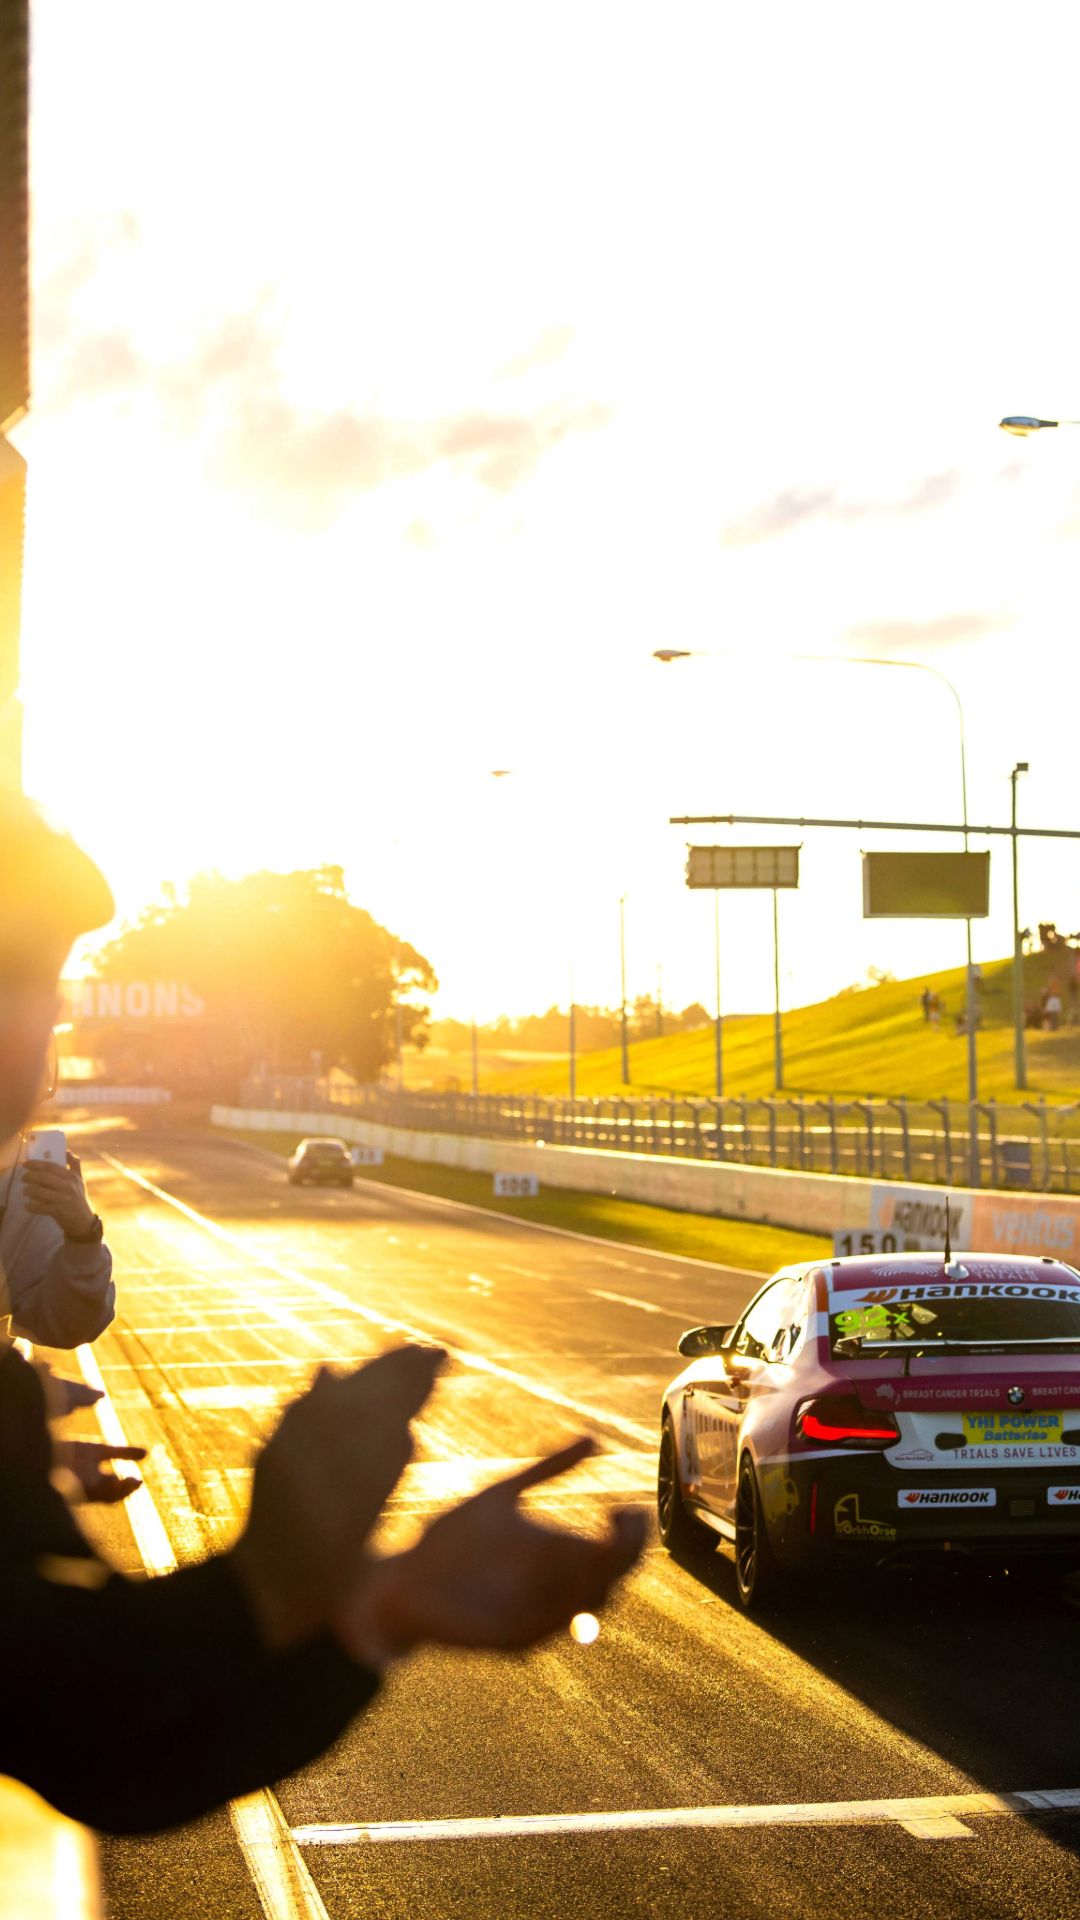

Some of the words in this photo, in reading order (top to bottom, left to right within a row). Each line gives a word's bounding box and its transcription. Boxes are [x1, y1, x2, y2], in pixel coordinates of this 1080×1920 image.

[840, 1233, 897, 1255] 150
[903, 1389, 934, 1399] BREAST
[936, 1388, 969, 1399] CANCER
[970, 1388, 1000, 1398] TRIALS
[1032, 1386, 1062, 1395] BREAST
[966, 1415, 995, 1429] YHI
[999, 1414, 1060, 1428] POWER
[983, 1430, 1048, 1441] Batteries
[953, 1448, 999, 1460] TRIALS
[1003, 1447, 1034, 1459] SAVE
[1039, 1446, 1076, 1457] LIVES
